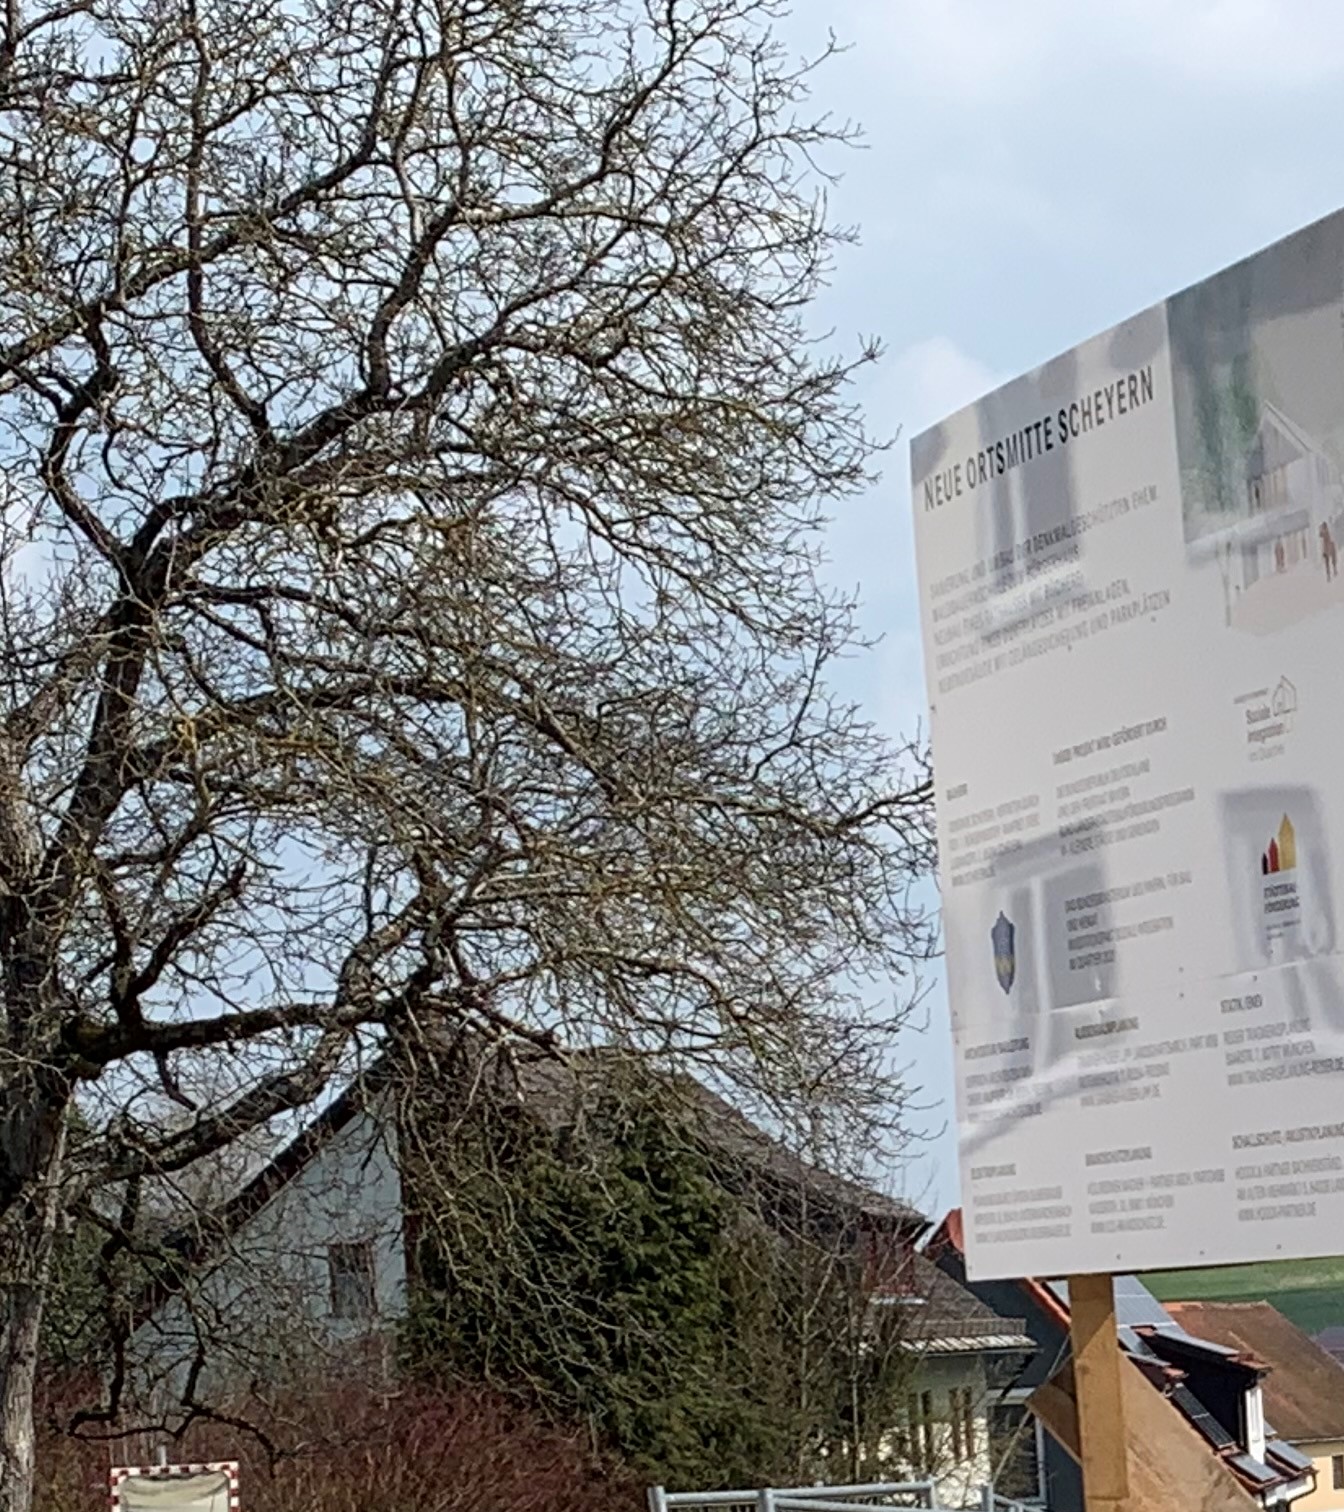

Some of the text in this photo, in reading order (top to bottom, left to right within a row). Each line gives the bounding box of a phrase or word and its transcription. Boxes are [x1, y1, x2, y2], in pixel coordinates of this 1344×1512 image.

[923, 366, 1153, 511] NEUE ORTSMITTE SCHEYERN
[1109, 589, 1171, 624] PARKPLÄTZEN
